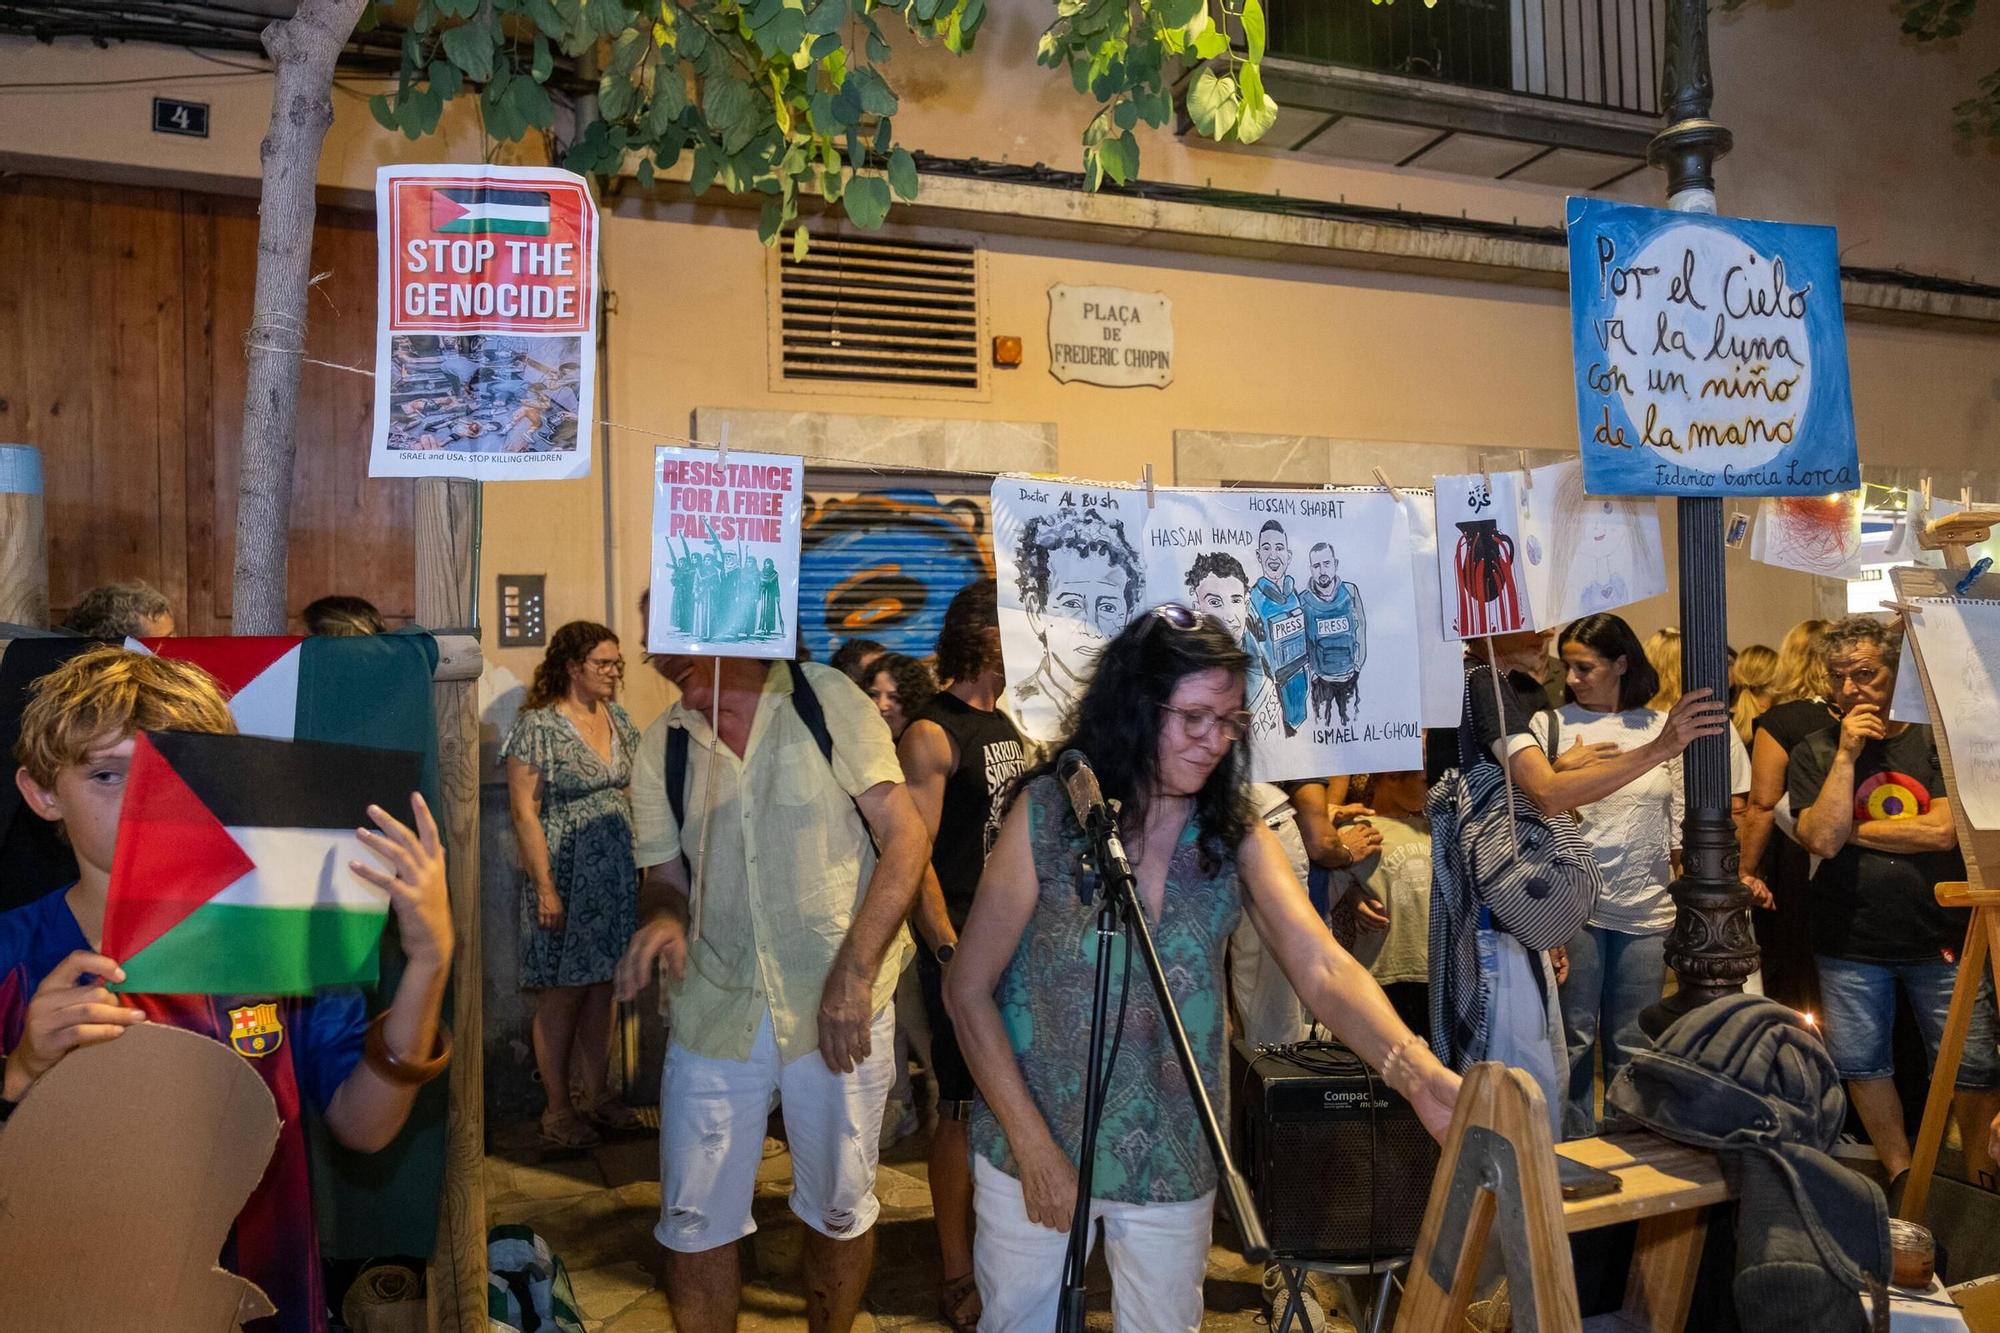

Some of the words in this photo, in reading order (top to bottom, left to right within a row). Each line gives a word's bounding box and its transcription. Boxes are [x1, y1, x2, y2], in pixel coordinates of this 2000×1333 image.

[171, 106, 191, 129] 4
[407, 239, 495, 274] STOP
[505, 240, 573, 275] THE
[1597, 235, 1660, 300] Por
[1667, 248, 1707, 311] el
[405, 282, 576, 318] GENOCIDE
[1083, 302, 1141, 326] PLAÇA
[1103, 327, 1122, 342] DE
[1652, 311, 1696, 360] la
[1703, 313, 1804, 366] luna
[1054, 343, 1120, 367] FREDERIC
[1124, 348, 1170, 370] CHOPIN
[1649, 368, 1688, 394] un
[1701, 366, 1800, 403] niño
[1593, 404, 1632, 449] de
[1641, 403, 1682, 453] la
[1687, 415, 1797, 450] mano
[399, 453, 427, 461] ISRAEL
[428, 453, 444, 461] and
[446, 453, 467, 462] USA:
[468, 455, 490, 464] STOP
[491, 455, 522, 464] KILLING
[523, 454, 563, 463] CHILDREN
[663, 460, 793, 492] RESISTANCE
[1655, 464, 1716, 488] Federico
[1785, 459, 1854, 487] Lorca
[670, 486, 713, 513] FOR
[715, 489, 730, 514] A
[733, 491, 784, 517] FREE
[1059, 489, 1077, 507] AL
[1249, 498, 1296, 516] HOSSAM
[1300, 498, 1345, 519] SHABAT
[669, 513, 782, 543] PALESTINE
[1151, 527, 1203, 547] HASSAN
[1211, 528, 1253, 546] HAMAD
[1275, 618, 1303, 639] PRESS
[1318, 619, 1348, 634] PRESS
[1313, 729, 1359, 745] ISMAEL
[1363, 722, 1422, 742] AL-GHOUL
[246, 1025, 267, 1036] FCB
